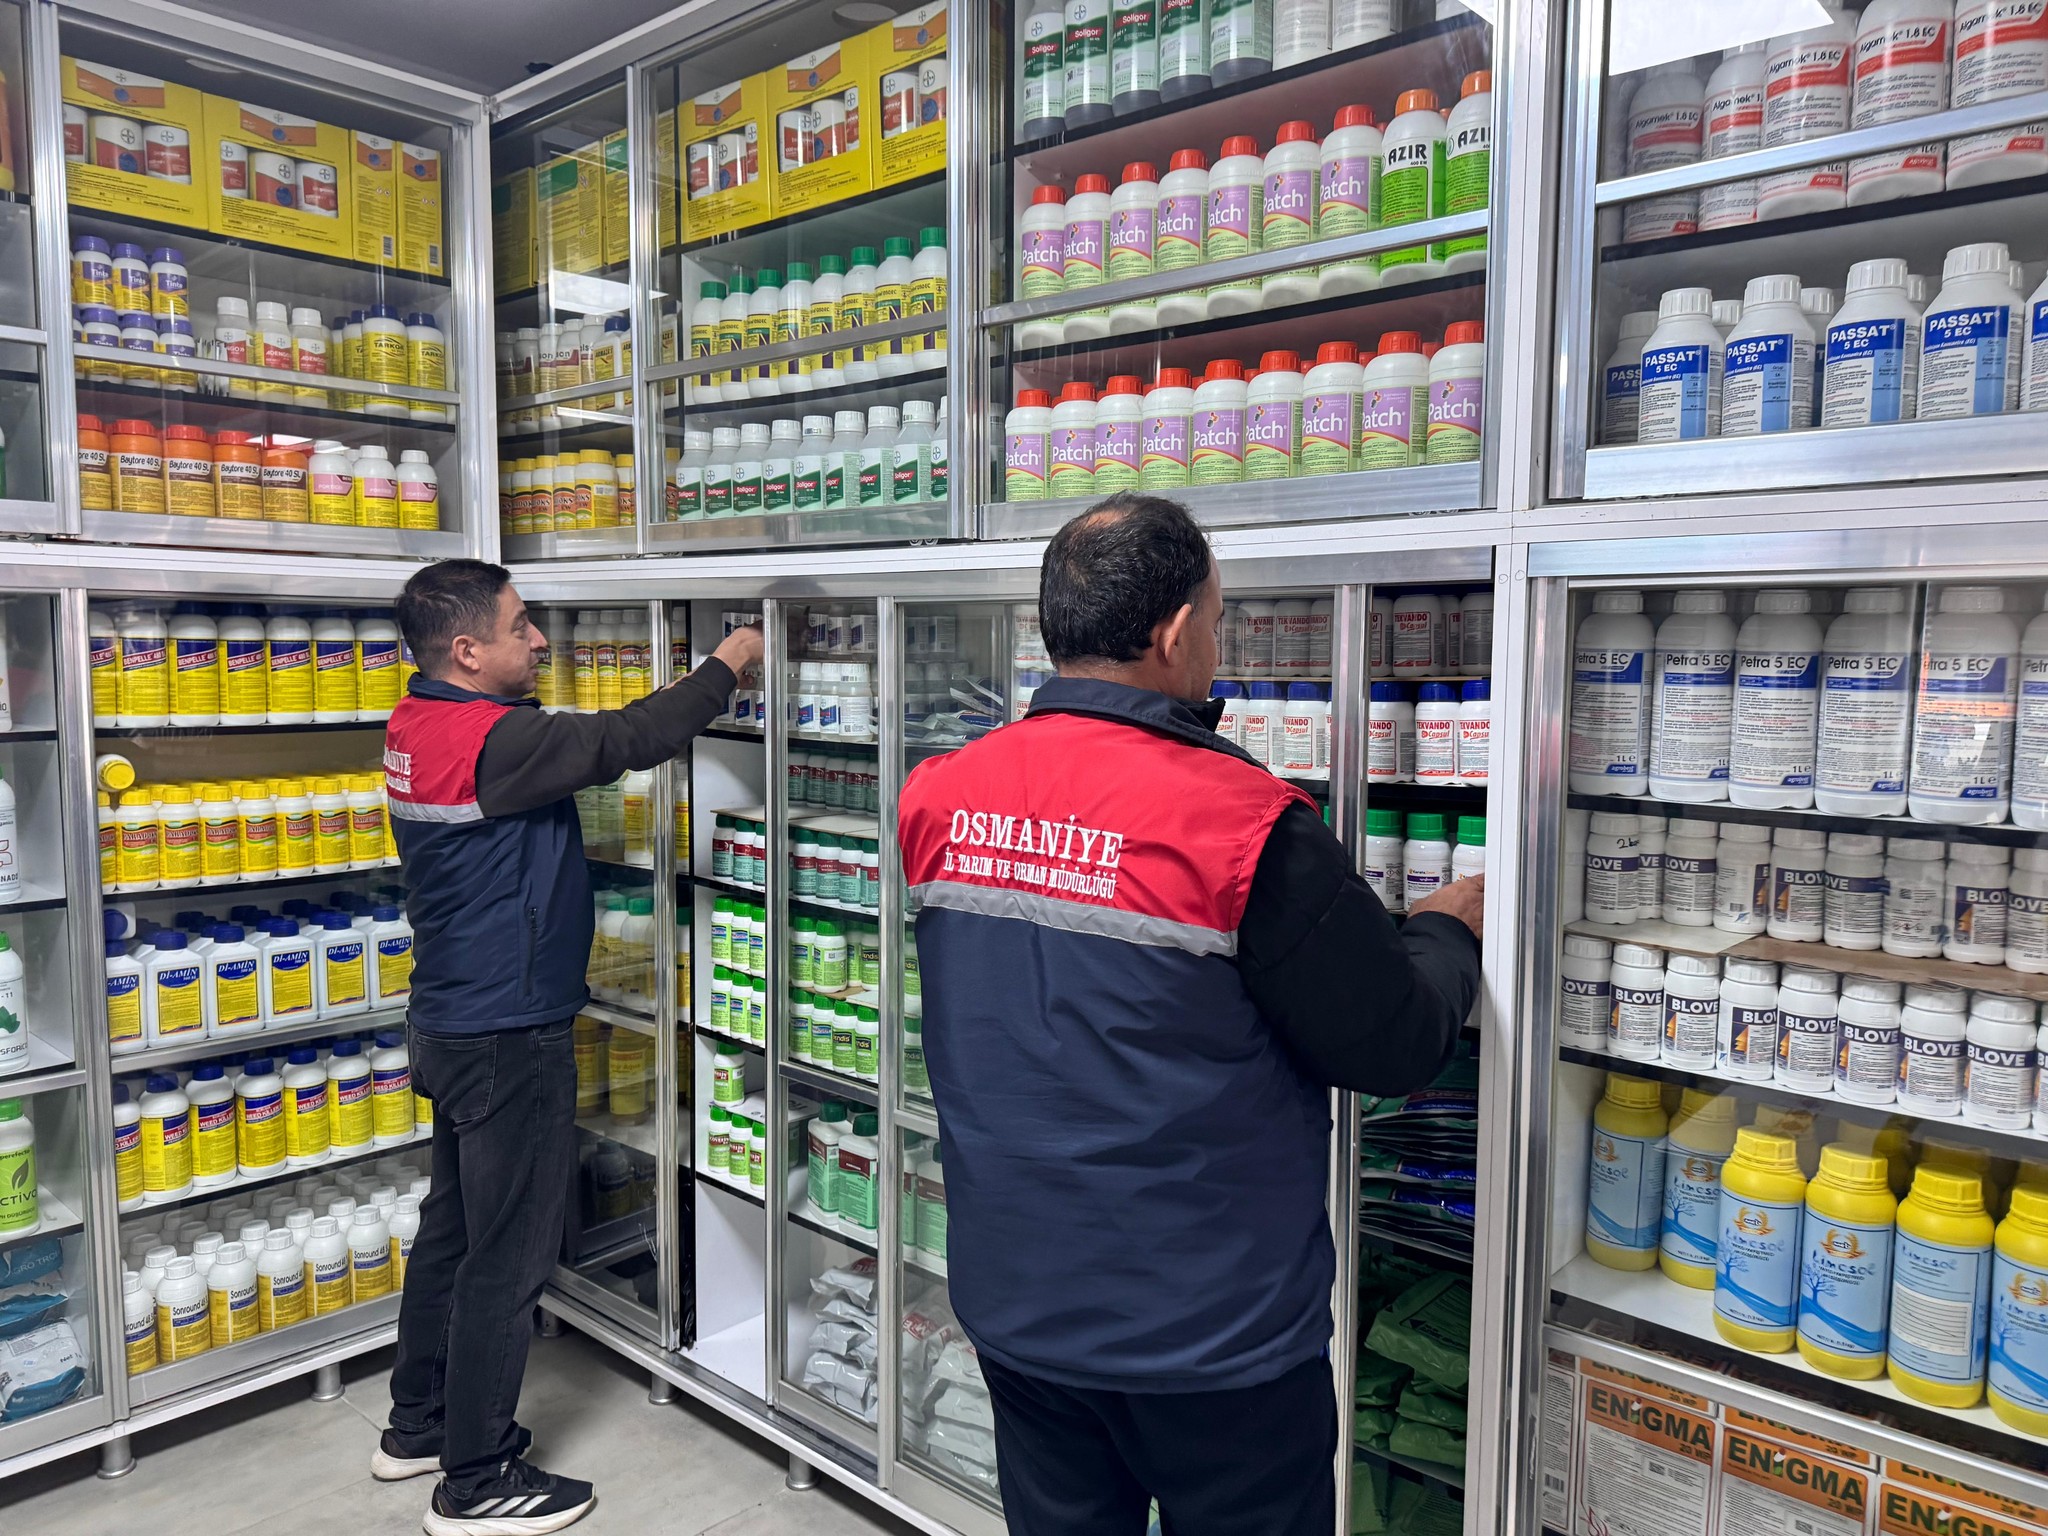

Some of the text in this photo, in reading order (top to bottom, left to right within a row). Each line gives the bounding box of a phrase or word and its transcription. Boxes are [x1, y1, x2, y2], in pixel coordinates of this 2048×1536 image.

[1122, 15, 1147, 24] Soligor
[1960, 8, 2007, 33] Algamk
[1075, 29, 1098, 38] Soligor
[1859, 30, 1900, 52] Algamk
[1032, 45, 1054, 54] Soligor
[1389, 144, 1427, 166] AZIR
[1023, 248, 1059, 265] Patch
[1944, 327, 1972, 338] 5 EC
[1844, 338, 1869, 350] 5 EC
[1737, 354, 1759, 365] 5 EC
[1656, 364, 1678, 373] 5 EC
[1143, 433, 1182, 453] Patch
[1193, 427, 1237, 447] Patch
[1052, 446, 1092, 462] Patch
[1095, 439, 1133, 458] Patch
[120, 455, 145, 466] Baytore
[169, 460, 193, 470] Baytore
[221, 464, 244, 474] Baytore
[263, 469, 284, 478] Baytore
[285, 469, 292, 478] 40
[1394, 613, 1427, 622] TEKVANDO
[123, 654, 151, 666] BENPELLE
[178, 655, 205, 666] BENPELLE
[1599, 653, 1607, 665] 5
[1612, 653, 1628, 664] EC
[1666, 654, 1730, 666] Petra 5 EC
[1740, 656, 1806, 669] Petra 5 EC
[1828, 657, 1898, 670] Petra 5 EC
[1924, 658, 1990, 671] etra 5 EC
[1417, 721, 1450, 730] TEKVANDO
[1428, 730, 1450, 740] Capsul
[949, 809, 1124, 869] OSMANİYE
[943, 846, 1117, 899] İL TARIM VE ORMAN MÜDÜRLÜĞÜ
[1616, 988, 1662, 1004] BLOVE
[1672, 998, 1719, 1013] BLOVE
[1785, 1016, 1837, 1032] BLOVE
[1844, 1027, 1898, 1043] BLOVE
[1904, 1037, 1961, 1057] BLOVE
[1967, 1044, 2025, 1066] BLOVE
[340, 1093, 356, 1101] WEED
[298, 1101, 314, 1110] WEED
[200, 1119, 218, 1128] WEED
[354, 1248, 379, 1259] Sonround
[316, 1260, 341, 1272] Sonround
[273, 1272, 298, 1285] Sonround
[230, 1286, 254, 1299] Sonround
[172, 1303, 200, 1316] Sonround
